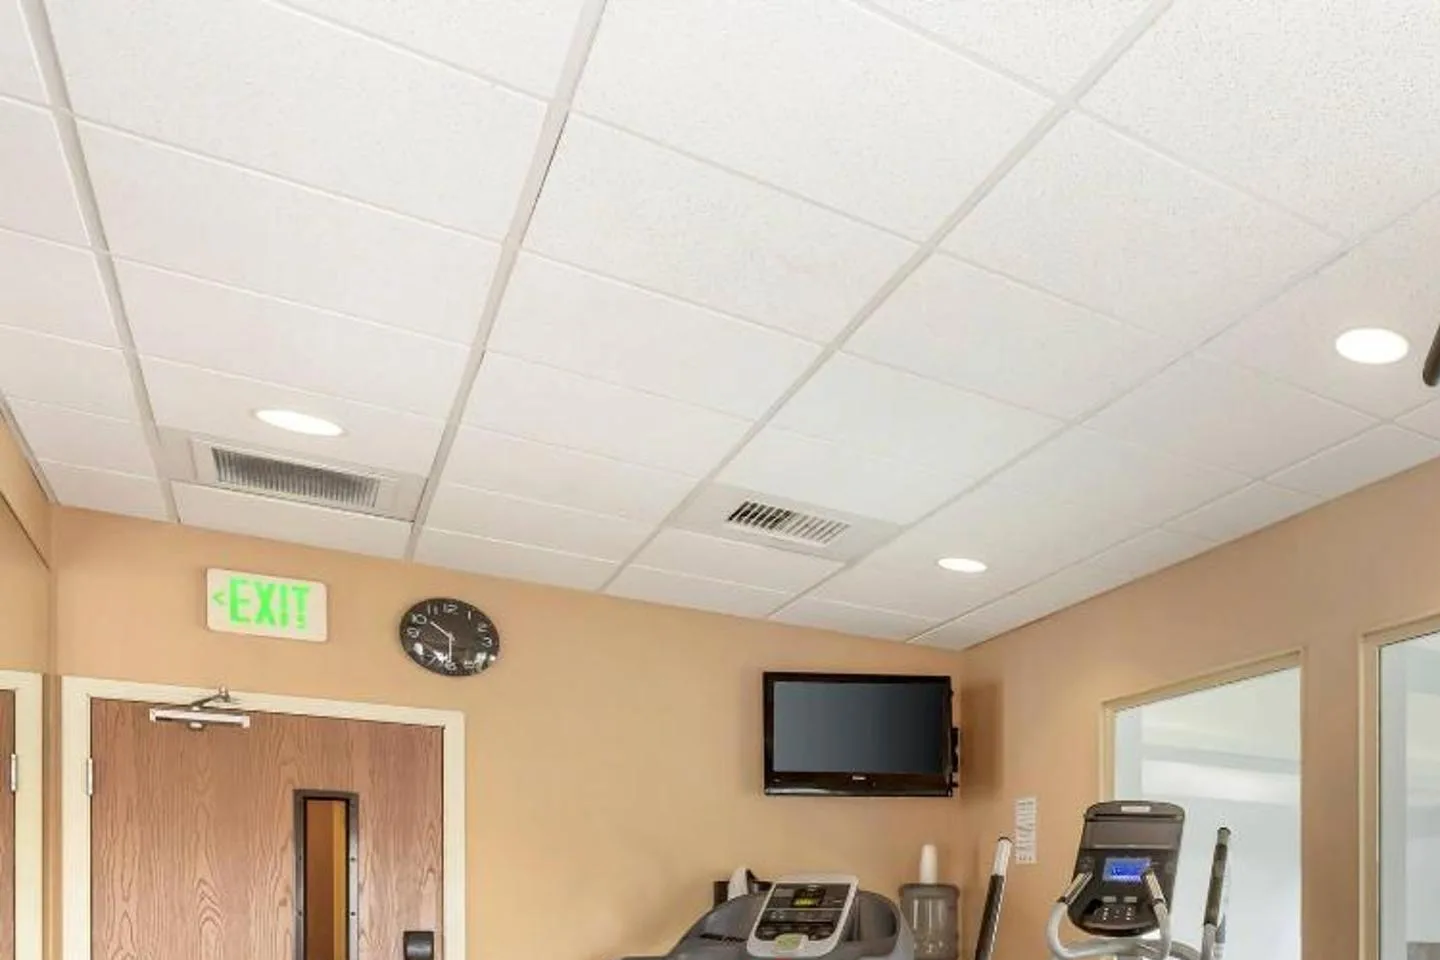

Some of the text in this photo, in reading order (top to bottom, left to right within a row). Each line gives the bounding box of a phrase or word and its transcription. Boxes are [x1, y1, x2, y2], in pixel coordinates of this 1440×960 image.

[229, 577, 310, 630] EXIT
[443, 603, 458, 615] 12
[411, 614, 427, 625] 10
